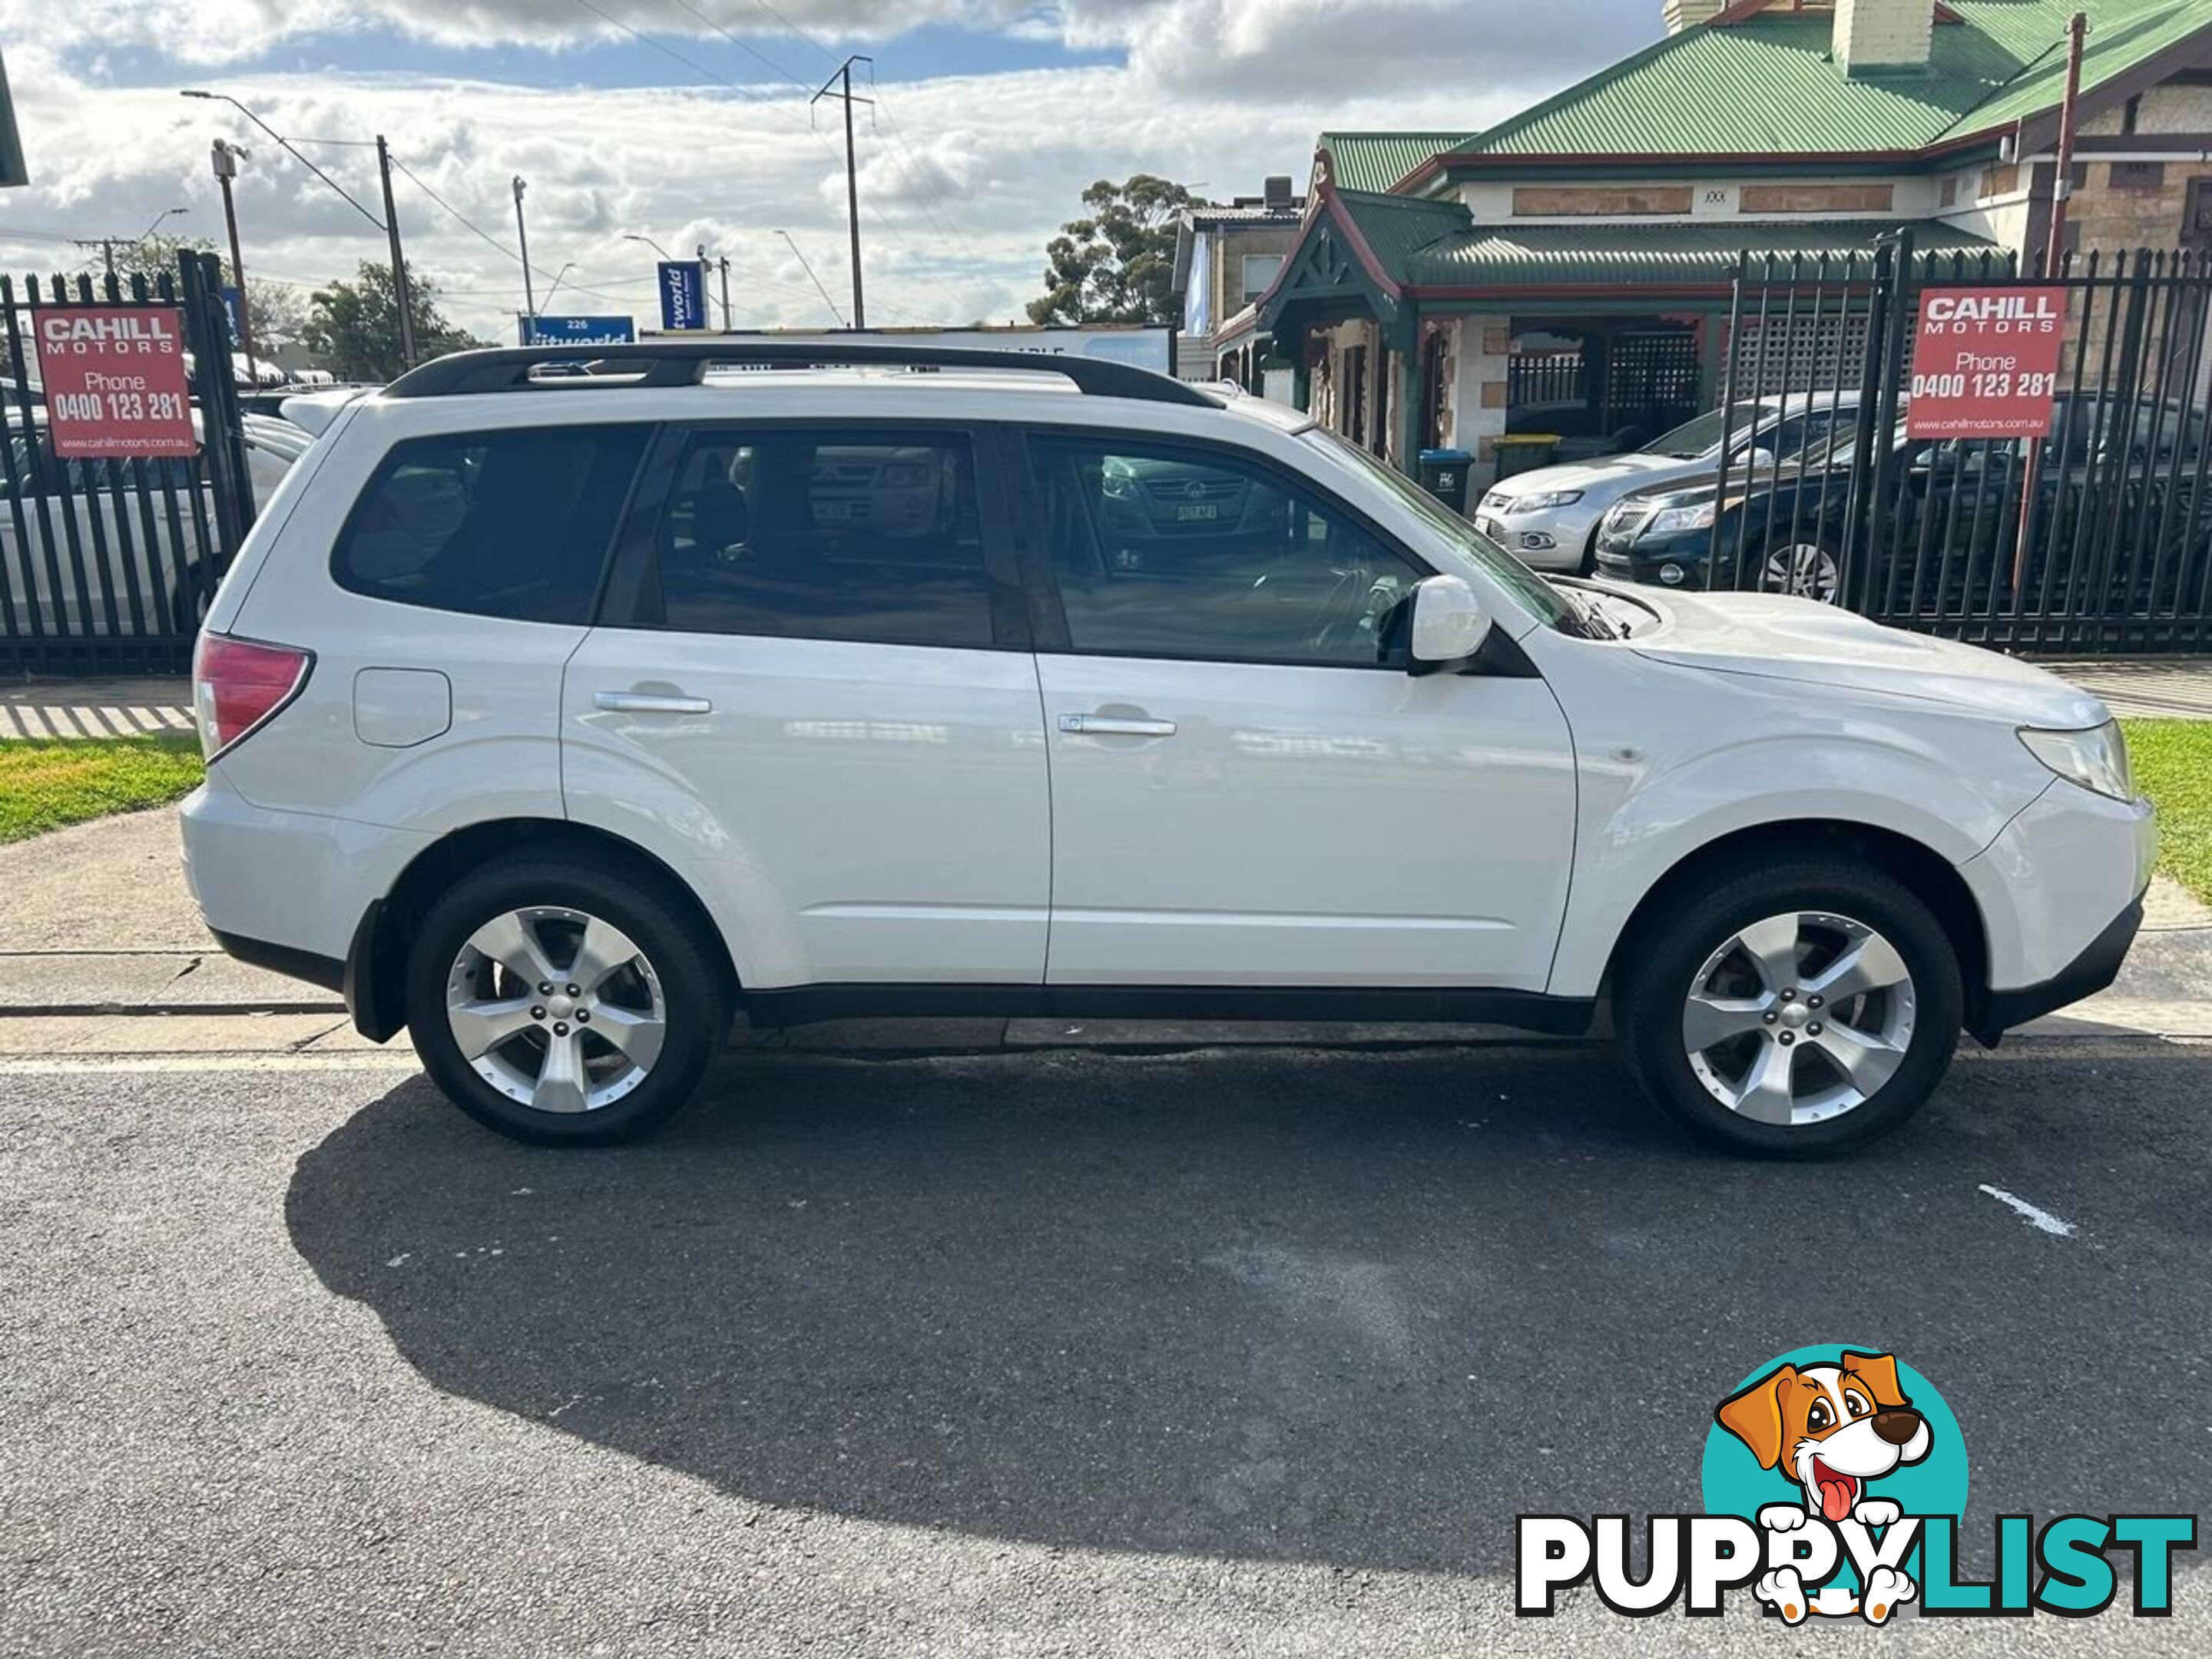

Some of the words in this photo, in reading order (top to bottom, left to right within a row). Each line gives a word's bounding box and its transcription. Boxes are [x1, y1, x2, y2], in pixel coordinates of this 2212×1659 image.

[1926, 296, 2057, 321] CAHILL
[44, 317, 172, 340] CAHILL
[1925, 320, 2054, 334] MOTORS
[46, 341, 173, 354] MOTORS
[1955, 352, 2016, 371] Phone
[84, 372, 146, 390] Phone
[1912, 373, 1965, 398] 0400
[1972, 373, 2011, 397] 123
[2016, 373, 2055, 397] 281
[55, 393, 103, 420] 0400
[107, 392, 144, 419] 123
[147, 392, 184, 419] 281
[1914, 418, 2044, 430] www.cahillmotors.com.au
[61, 437, 190, 449] www.cahillmotors.com.au
